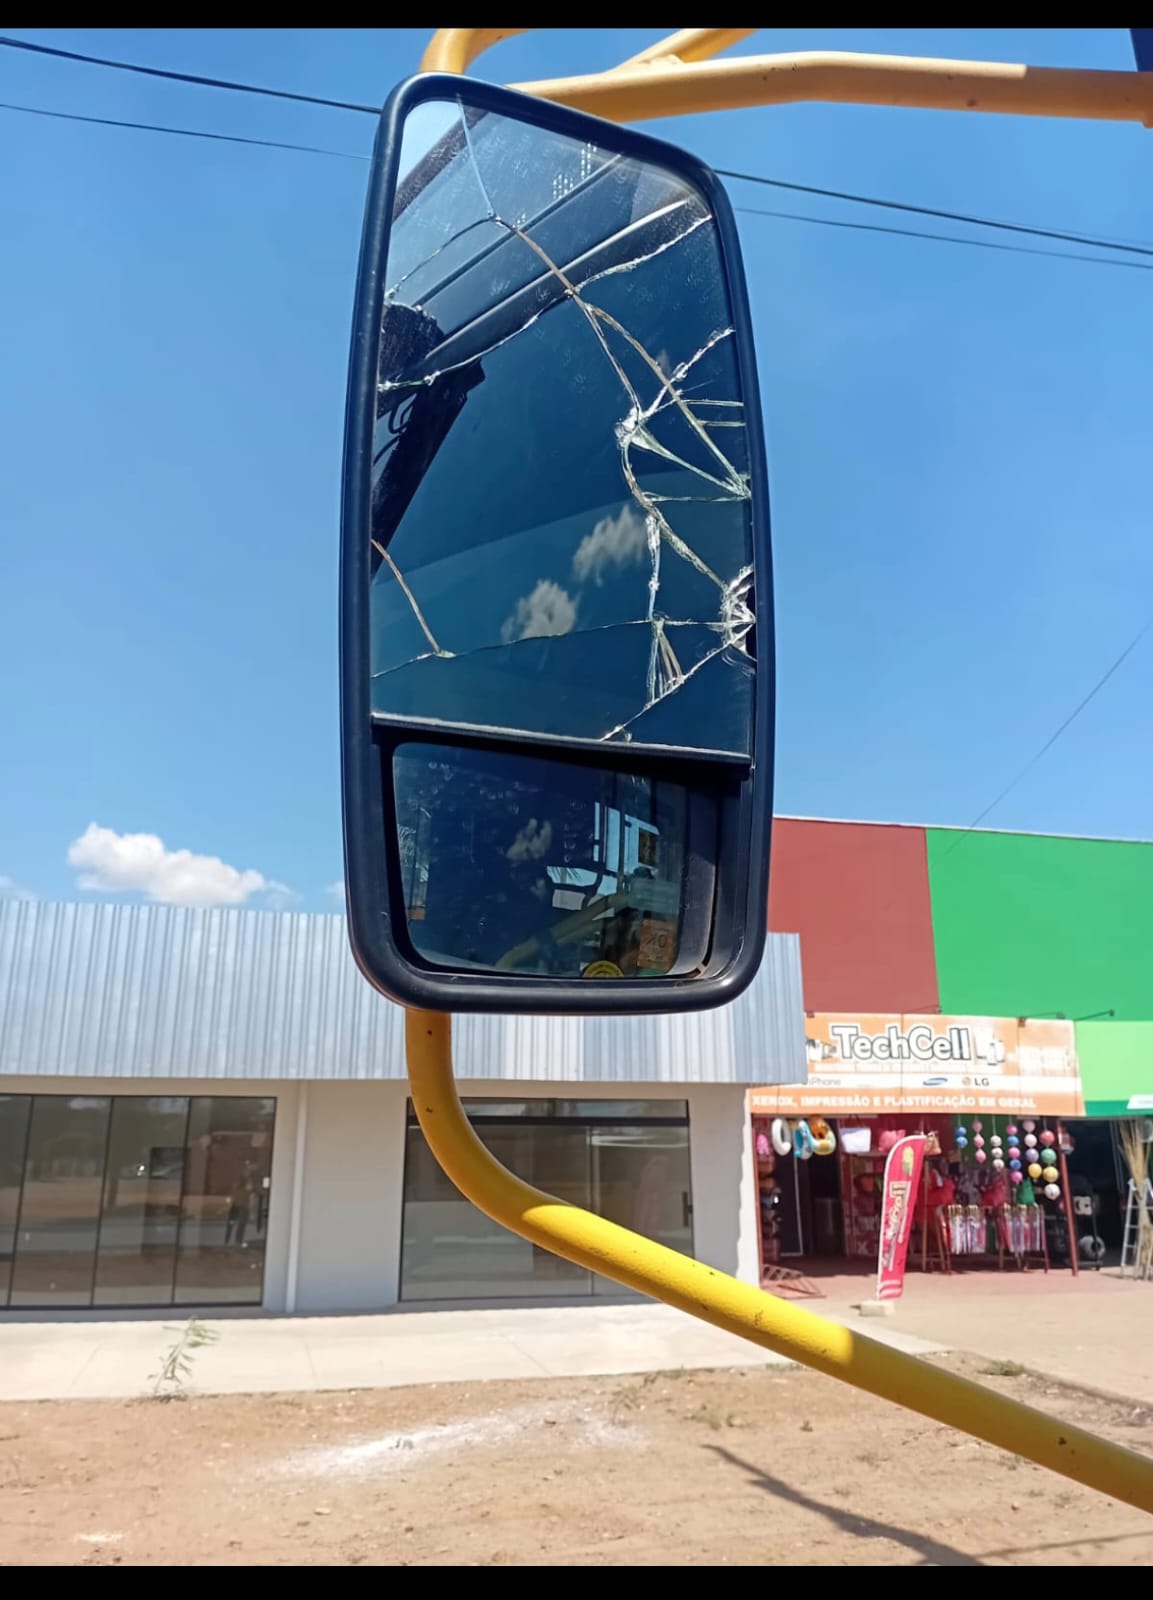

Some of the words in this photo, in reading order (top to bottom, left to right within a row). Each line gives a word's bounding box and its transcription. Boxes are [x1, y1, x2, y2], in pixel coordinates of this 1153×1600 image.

[831, 1025, 972, 1062] TechCell
[973, 1077, 990, 1087] LG
[801, 1094, 870, 1107] IMPRESSÃO
[873, 1096, 881, 1107] E
[884, 1095, 976, 1109] PLASTIFICAÇÃO
[978, 1096, 996, 1108] EM
[998, 1097, 1036, 1109] GERAL
